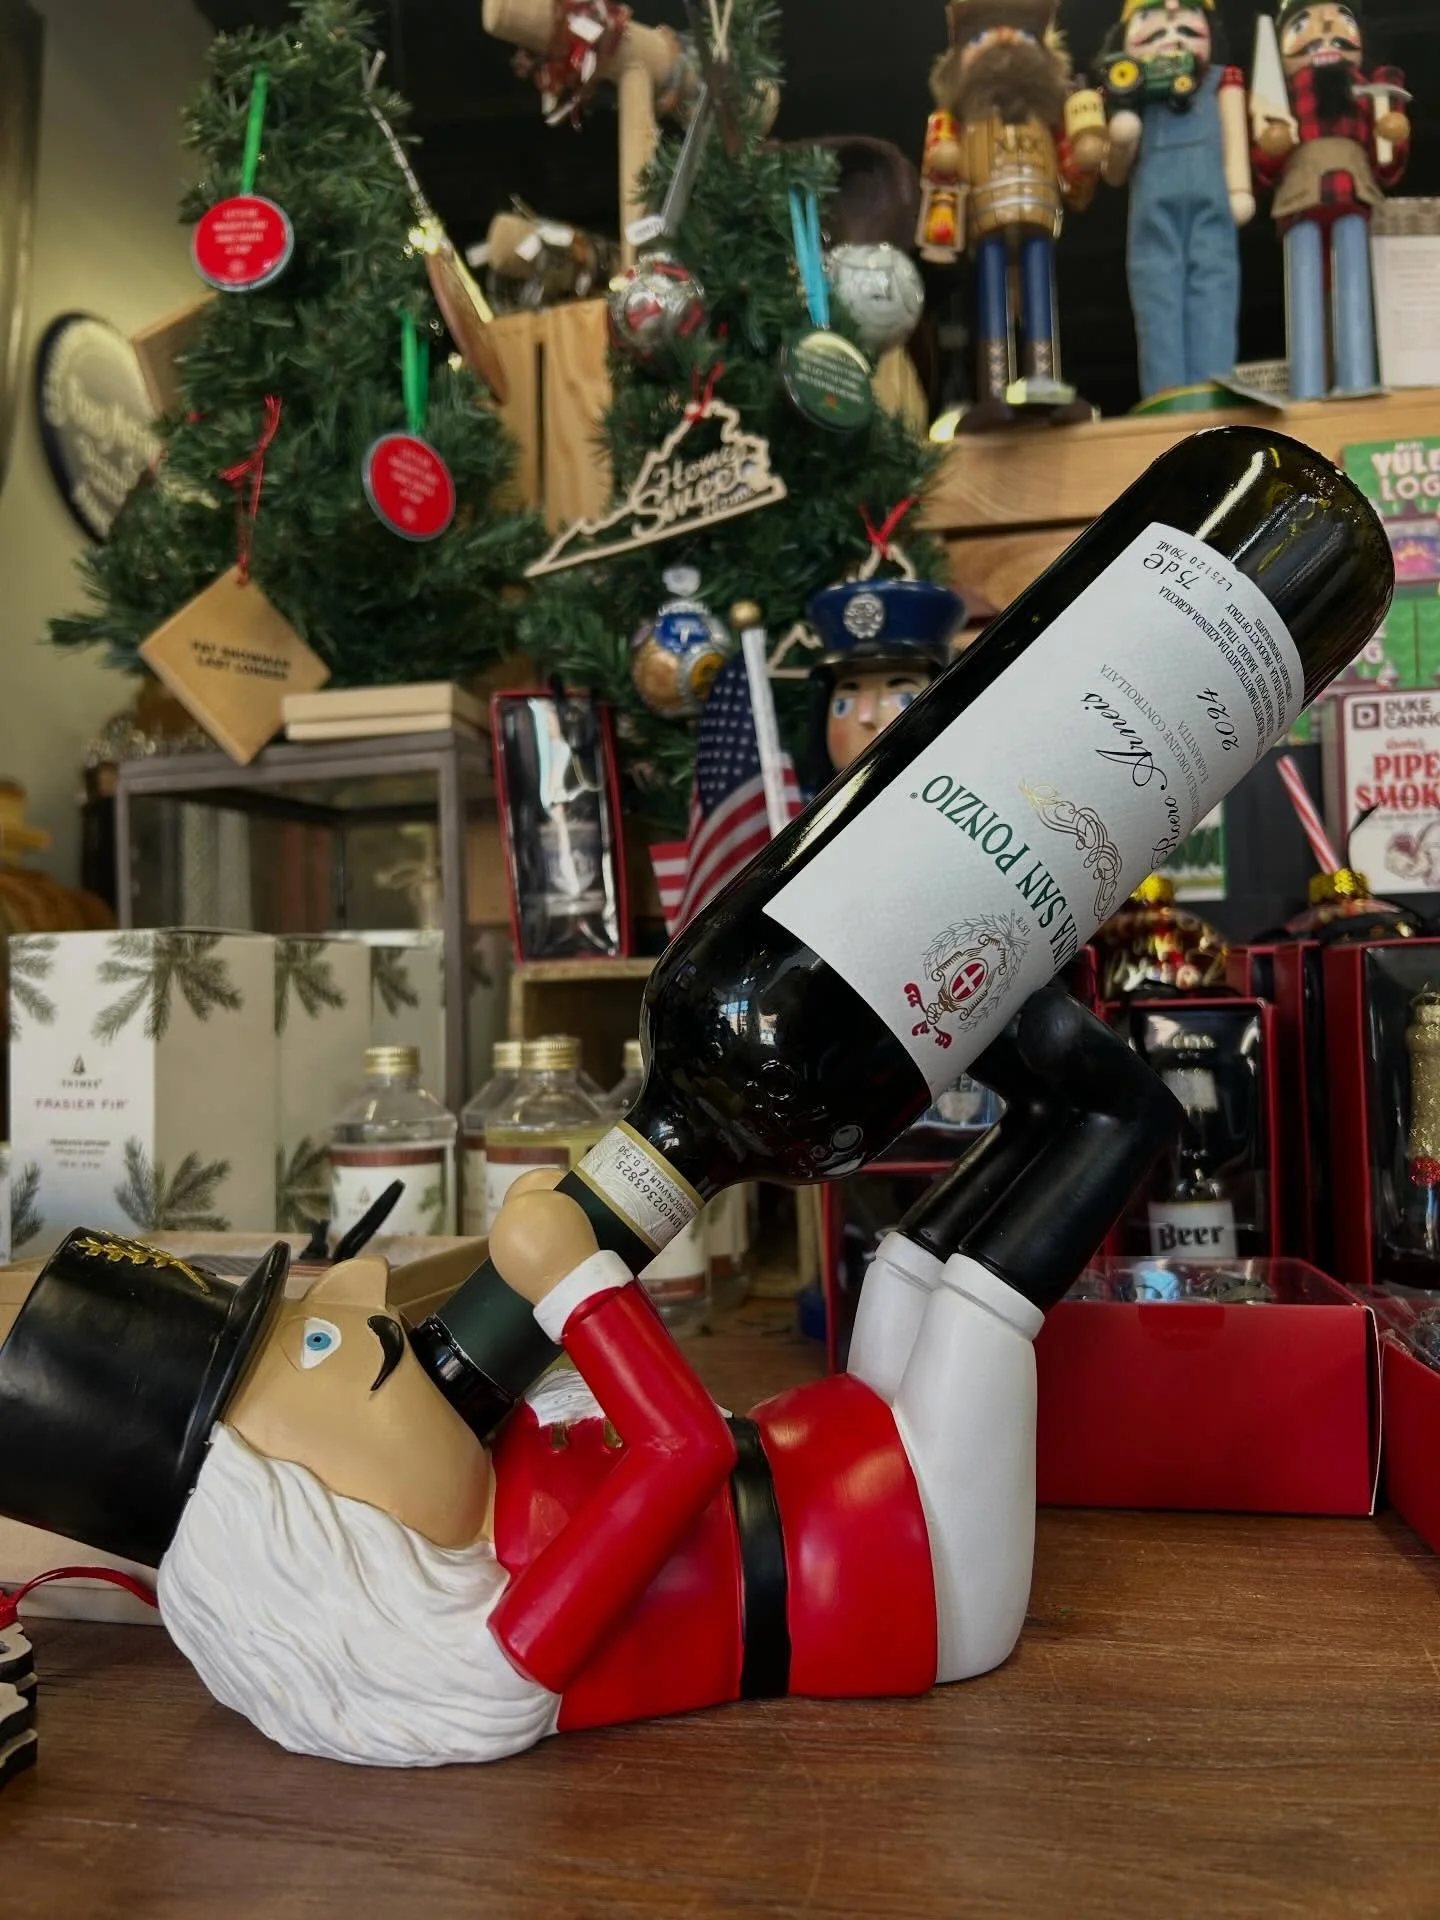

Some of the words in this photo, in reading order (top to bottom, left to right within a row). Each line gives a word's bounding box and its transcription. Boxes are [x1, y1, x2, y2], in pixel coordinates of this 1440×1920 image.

[1372, 449, 1440, 476] YULE
[1381, 475, 1440, 501] LOG
[1157, 540, 1173, 552] ML
[1169, 547, 1187, 560] 750
[1175, 570, 1199, 590] 75
[1159, 586, 1196, 616] AGRICOLA
[1225, 603, 1246, 625] ITALY
[1192, 611, 1222, 643] AZIENDA
[1218, 618, 1240, 644] ITALIA
[1240, 621, 1253, 634] OF
[1217, 638, 1230, 654] DA
[1237, 643, 1259, 673] BAROLO
[1248, 631, 1274, 668] PRODUCT
[1225, 650, 1259, 705] IMBOTTIGLIATO
[1254, 673, 1270, 703] PONZIO
[1269, 667, 1283, 692] ITALIA
[1100, 664, 1167, 733] CONTROLLATA
[1384, 697, 1430, 712] DUKE
[1196, 688, 1239, 751] 2024
[1080, 692, 1167, 790] Arneis
[1164, 730, 1194, 775] ORIGINE
[1177, 720, 1210, 778] GARANTITA
[1373, 753, 1440, 782] PIPE
[1151, 795, 1180, 869] Roero
[1016, 861, 1068, 928] SAN
[1016, 915, 1031, 937] 1878
[1049, 913, 1079, 974] LINA
[616, 1143, 641, 1167] 0.750
[1158, 1224, 1224, 1251] Beer
